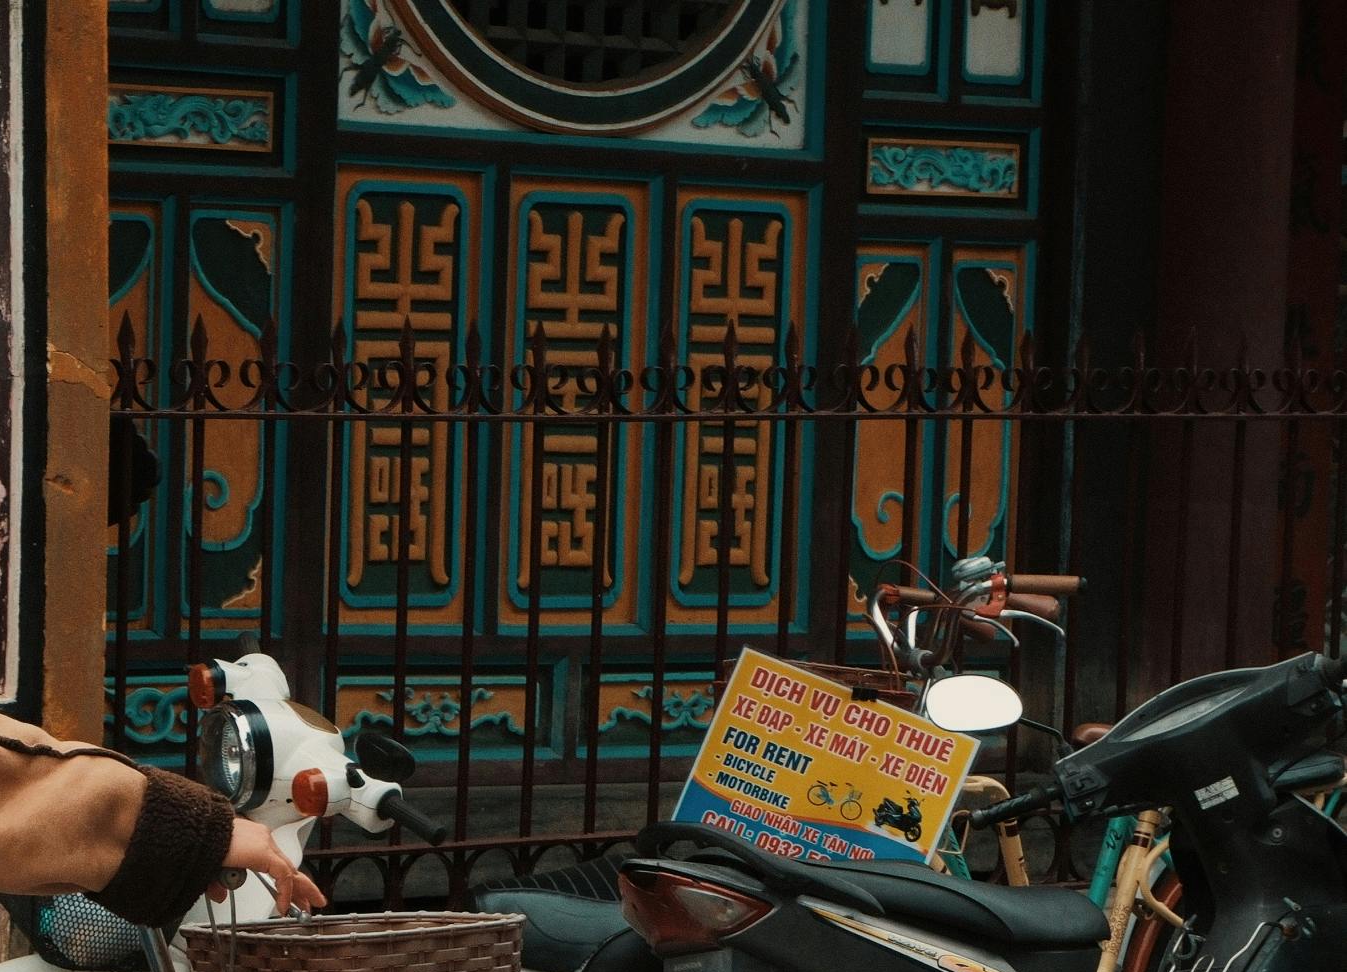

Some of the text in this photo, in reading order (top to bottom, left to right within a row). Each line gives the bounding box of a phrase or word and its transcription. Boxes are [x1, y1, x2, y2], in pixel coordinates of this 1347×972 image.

[750, 667, 954, 763] DỊCH VỤ CHO THUÊ
[722, 726, 813, 775] FOR RENT
[723, 753, 776, 783] BICYCLE
[732, 695, 757, 720] XE
[756, 705, 793, 733] ĐẠP
[803, 723, 829, 748] XE
[828, 733, 870, 763] MÁY
[879, 753, 905, 778] XE
[904, 763, 948, 796] ĐIỆN
[716, 771, 791, 810] MOTORBIKE
[731, 800, 762, 820] GIAO
[802, 826, 822, 843] XE
